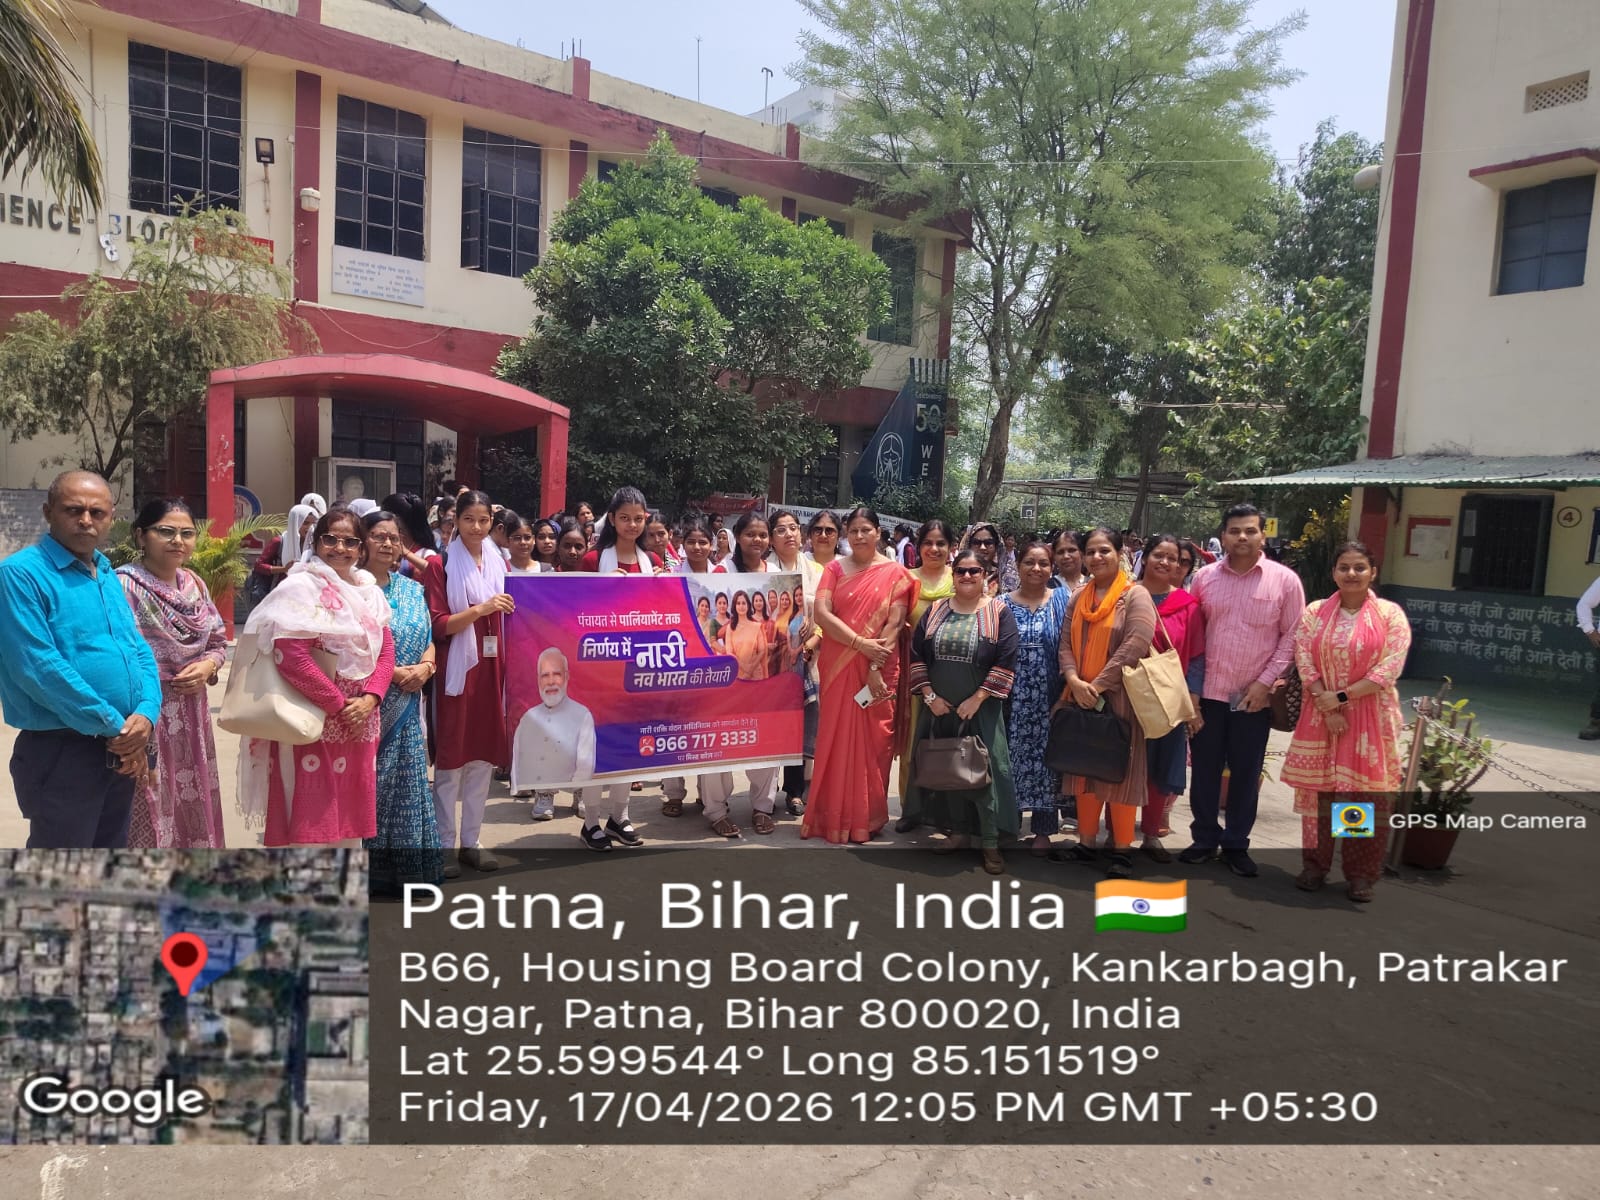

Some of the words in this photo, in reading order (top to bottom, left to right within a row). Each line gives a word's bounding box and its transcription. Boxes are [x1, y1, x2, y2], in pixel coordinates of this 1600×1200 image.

[577, 612, 608, 628] पंचायत
[610, 612, 617, 627] से
[619, 610, 663, 626] पार्लियामेंट
[664, 612, 681, 625] तक
[1485, 602, 1505, 619] जो
[1507, 606, 1535, 622] आप
[1443, 620, 1464, 635] एक
[1530, 624, 1543, 646] है
[582, 636, 619, 658] निर्णय
[621, 636, 632, 657] में
[634, 631, 687, 669] नारी
[633, 672, 656, 688] नव
[657, 670, 688, 687] भारत
[689, 668, 703, 685] की
[704, 665, 731, 684] तैयारी
[655, 735, 688, 753] 966
[691, 733, 717, 749] 717
[720, 730, 757, 747] 3333
